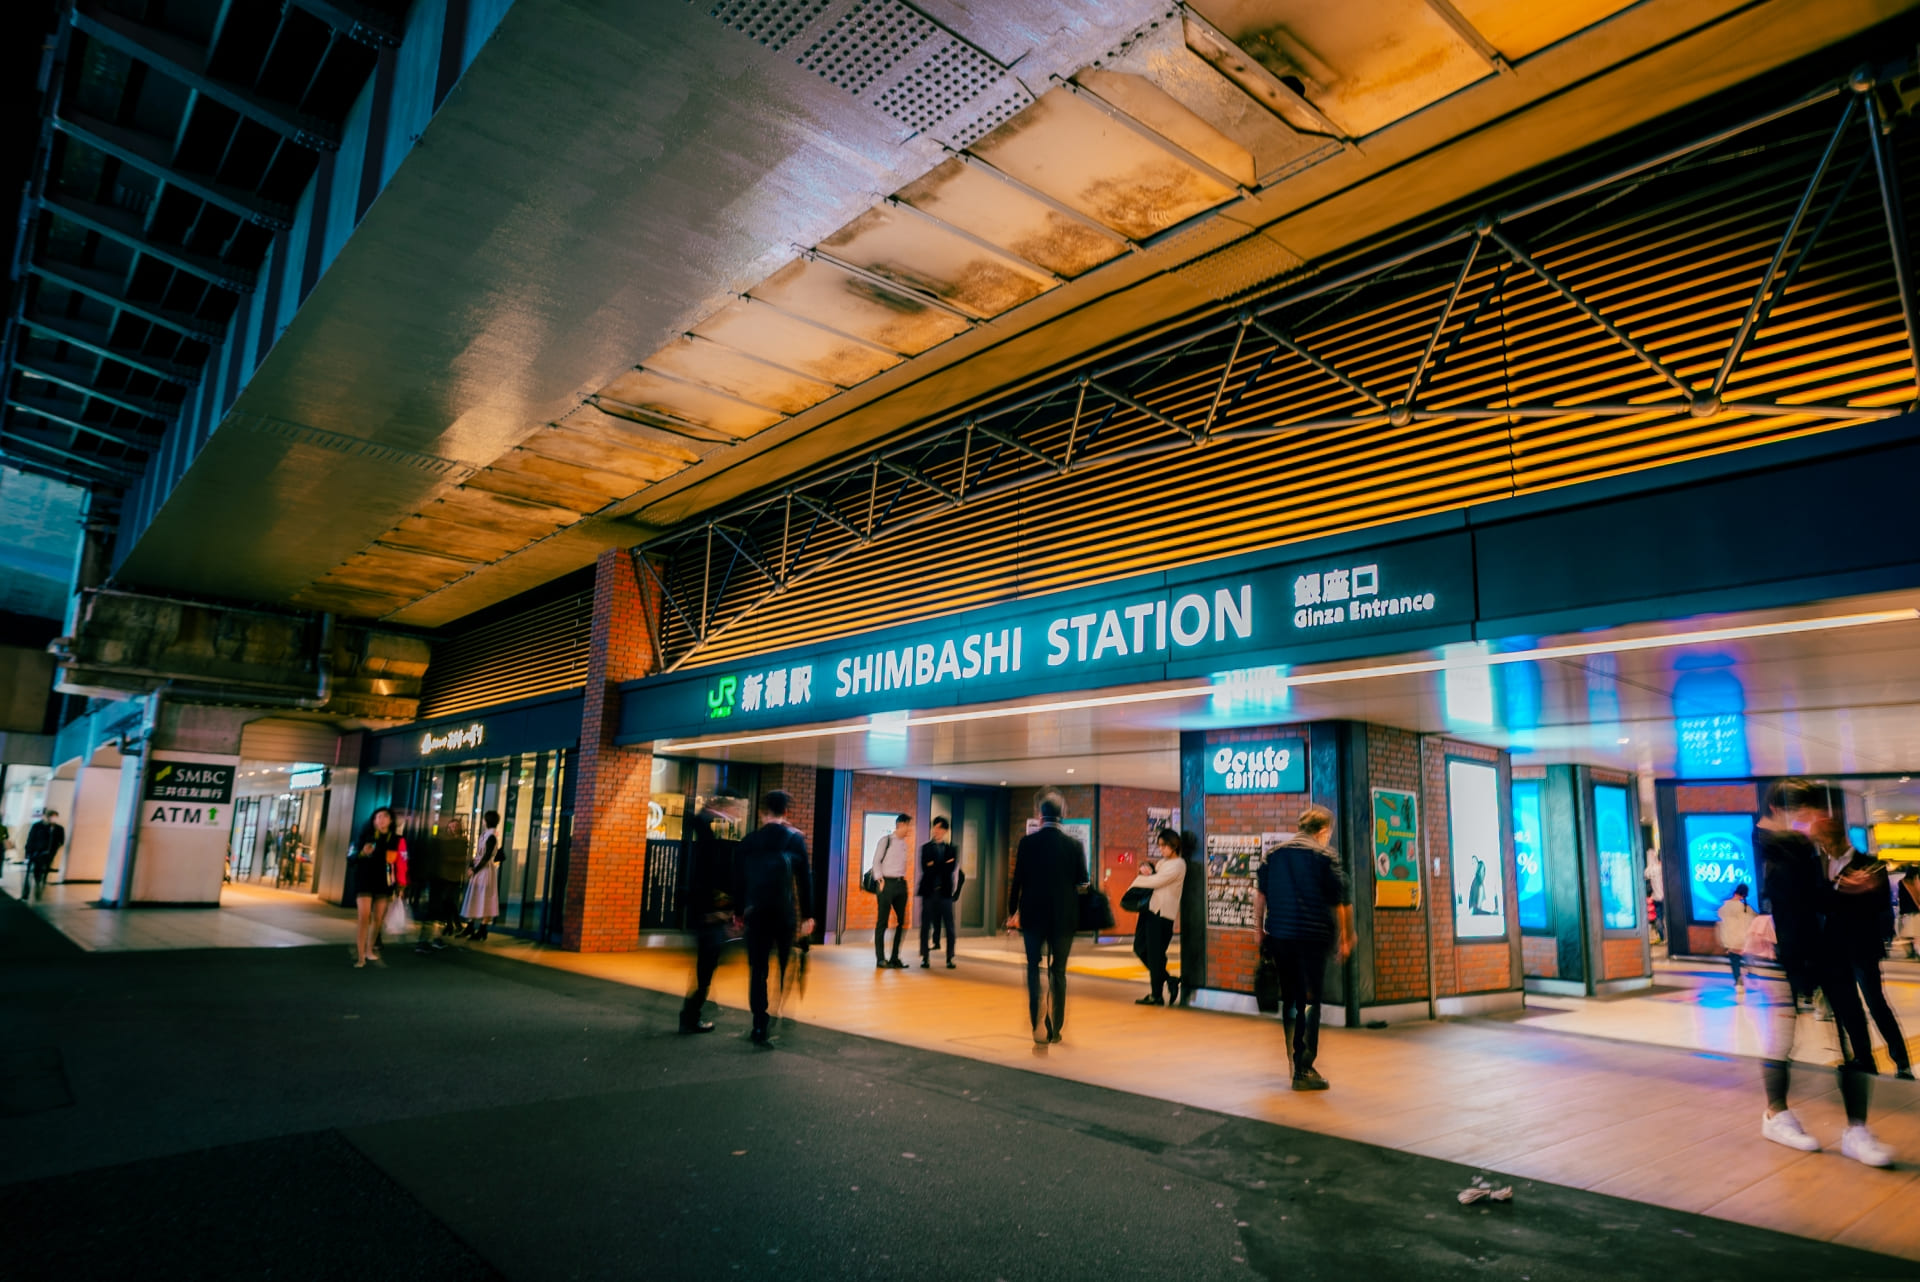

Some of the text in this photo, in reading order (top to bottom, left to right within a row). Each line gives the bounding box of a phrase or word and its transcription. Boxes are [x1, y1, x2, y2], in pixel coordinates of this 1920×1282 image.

[1294, 563, 1379, 607] 銀座口
[1294, 592, 1436, 628] Ginza Entrance
[836, 584, 1253, 699] SHIMBASHI STATION
[708, 675, 737, 708] JR
[741, 664, 813, 712] 新橋駅
[153, 785, 223, 799] 三井住友銀行
[175, 768, 227, 785] SMBC
[1225, 770, 1279, 790] EDITION
[150, 806, 202, 824] ATM
